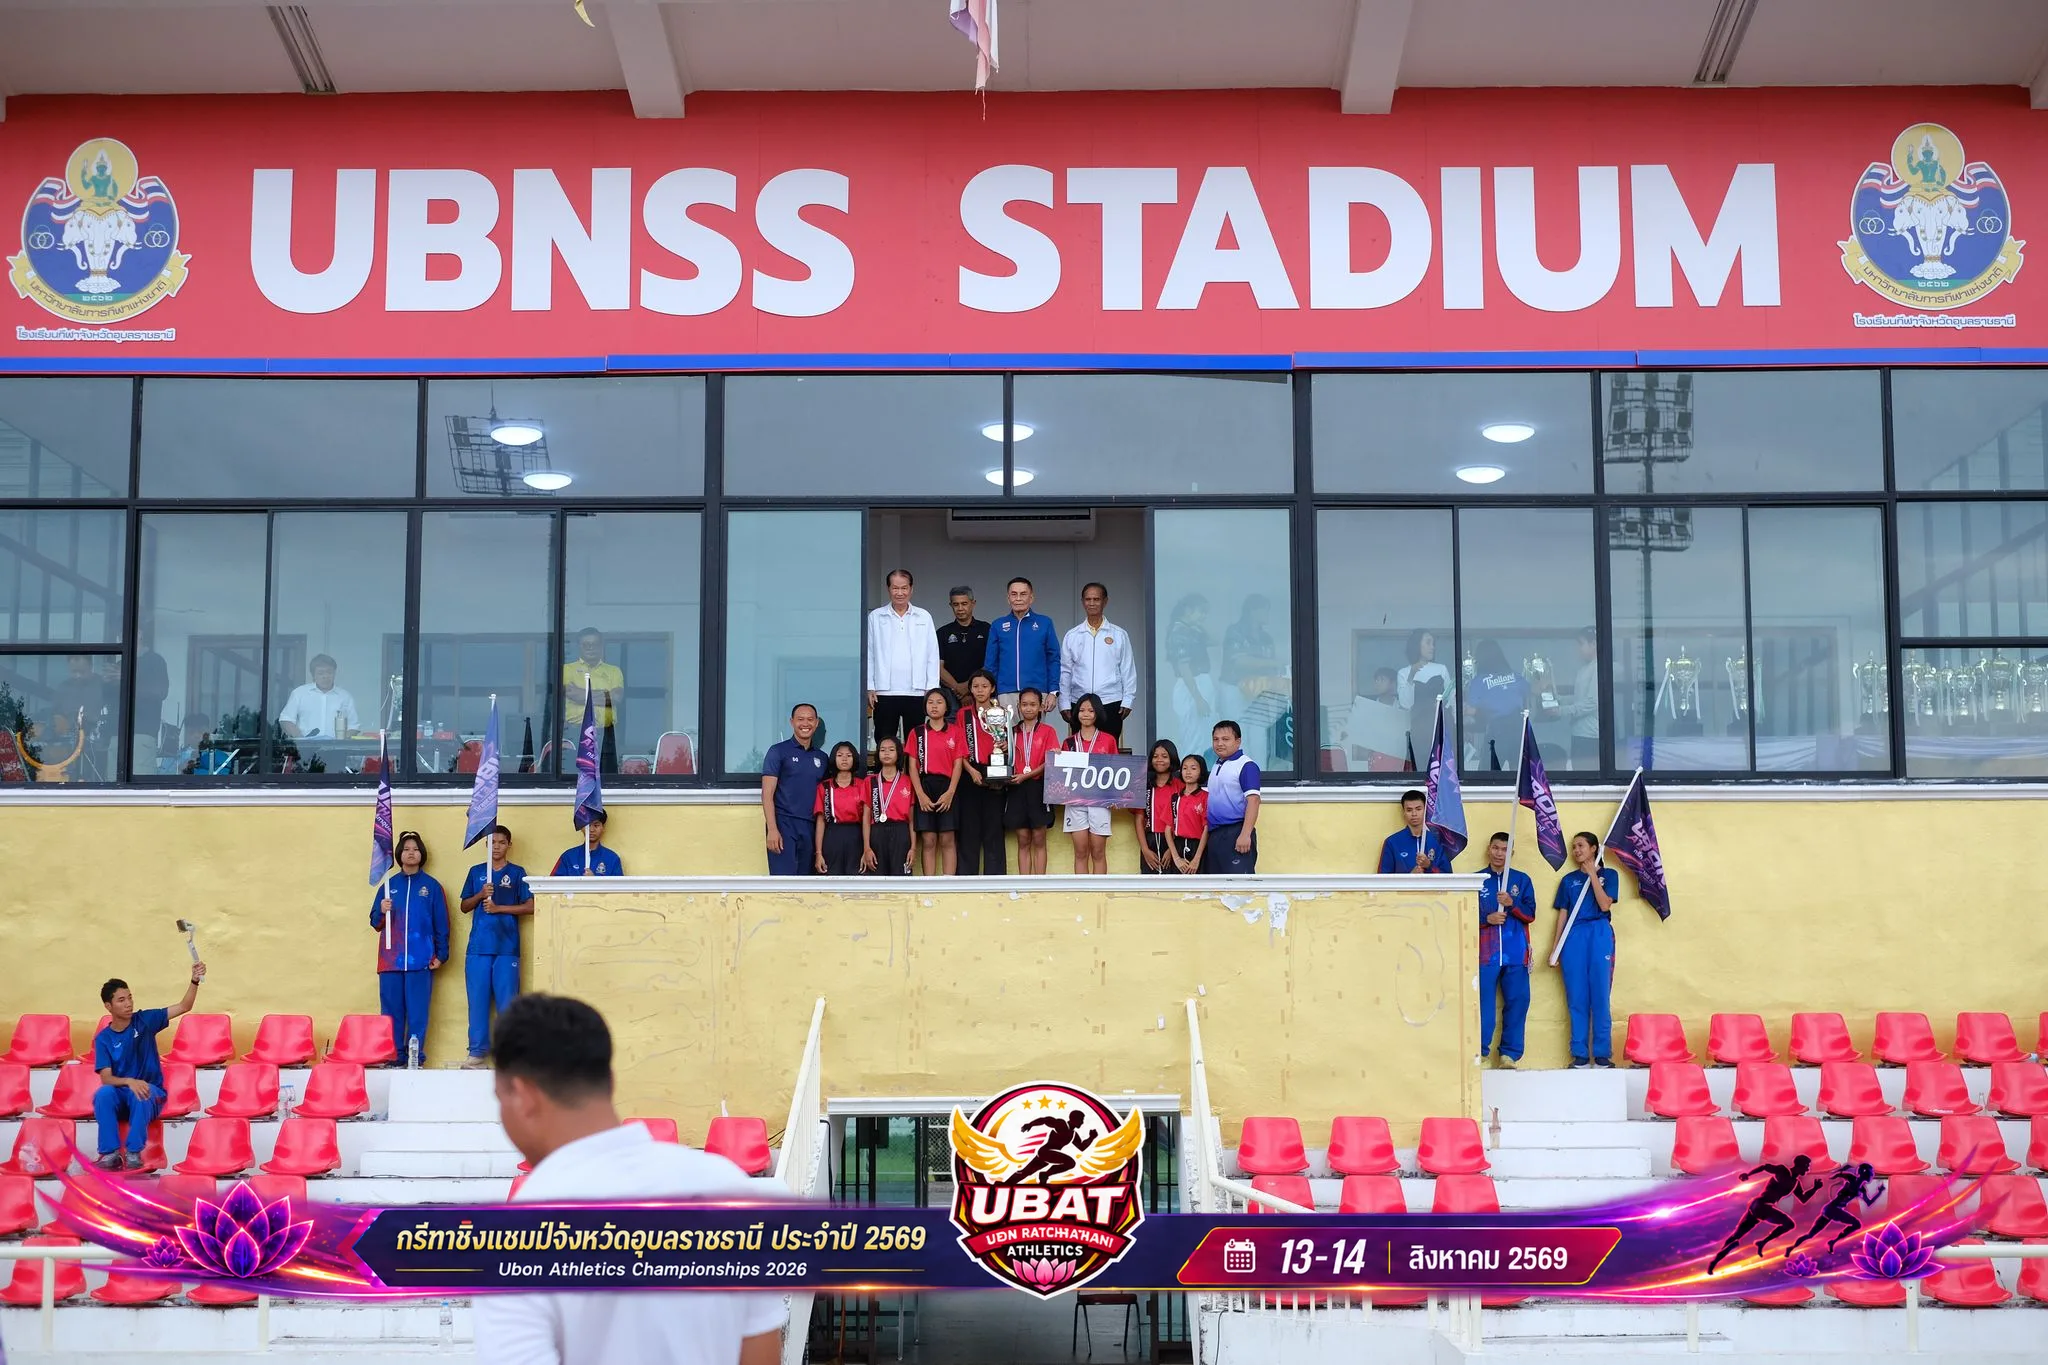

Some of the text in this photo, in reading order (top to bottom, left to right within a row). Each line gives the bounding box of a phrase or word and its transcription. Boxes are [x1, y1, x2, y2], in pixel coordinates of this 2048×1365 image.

[250, 163, 1782, 318] UBNSS STADIUM
[1854, 314, 2015, 329] โรงเรียนกีฬาจังหวัดอุบลราชธานี
[17, 327, 175, 343] โรงเรียนกีฬาจังหวัดอุบลราชธานี
[1062, 765, 1131, 791] 1,000
